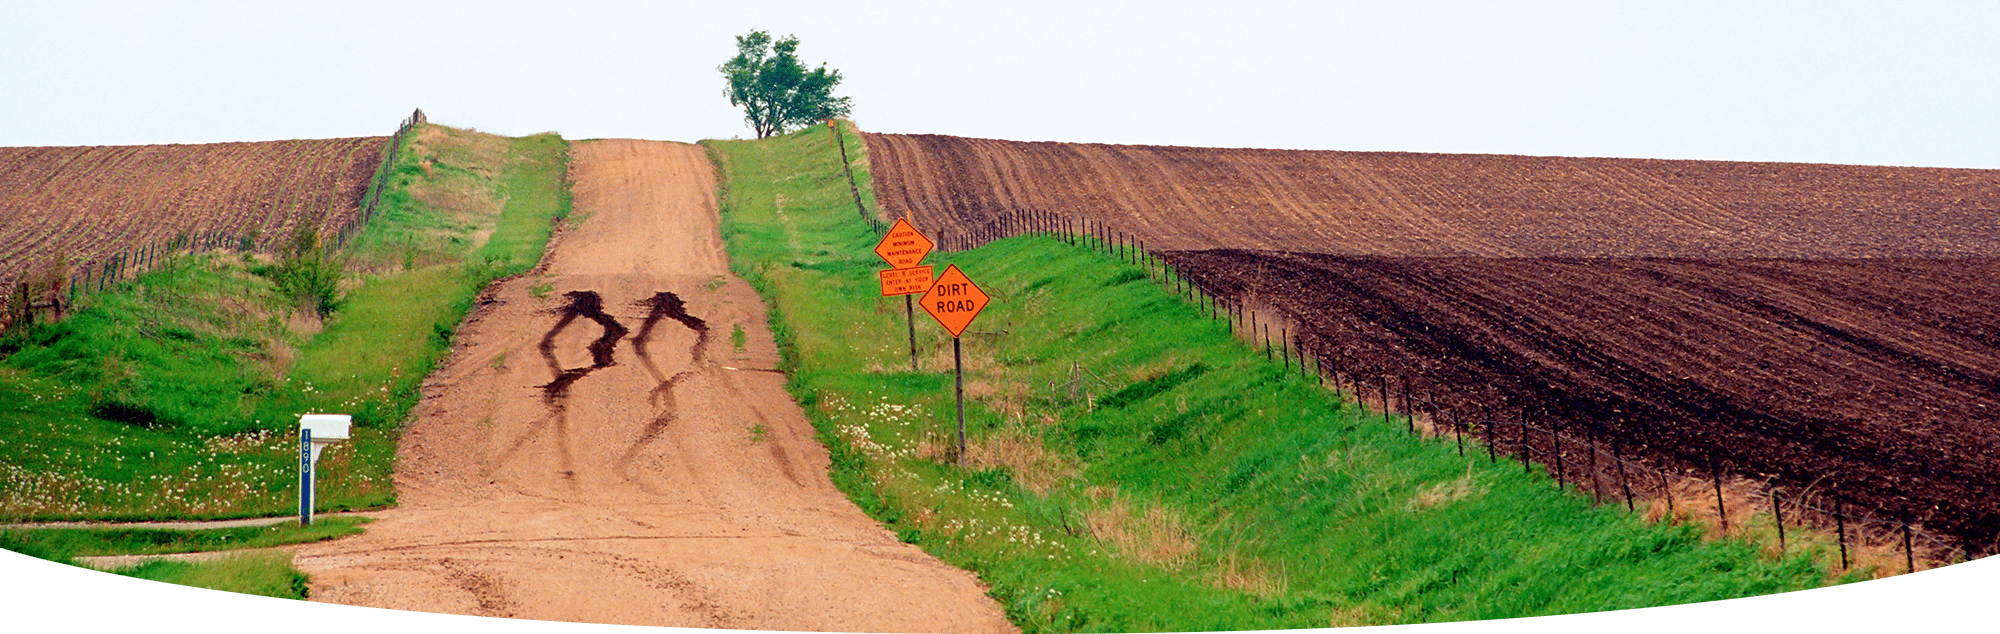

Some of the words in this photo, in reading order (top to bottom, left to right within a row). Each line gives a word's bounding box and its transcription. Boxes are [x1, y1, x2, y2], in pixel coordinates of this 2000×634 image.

[887, 248, 922, 256] MAINTENANCE
[898, 257, 913, 265] ROAD
[882, 271, 898, 279] LEVEL
[909, 268, 930, 276] SERVICE
[937, 283, 968, 297] DIRT
[936, 299, 975, 313] ROAD
[302, 430, 310, 474] 1890
